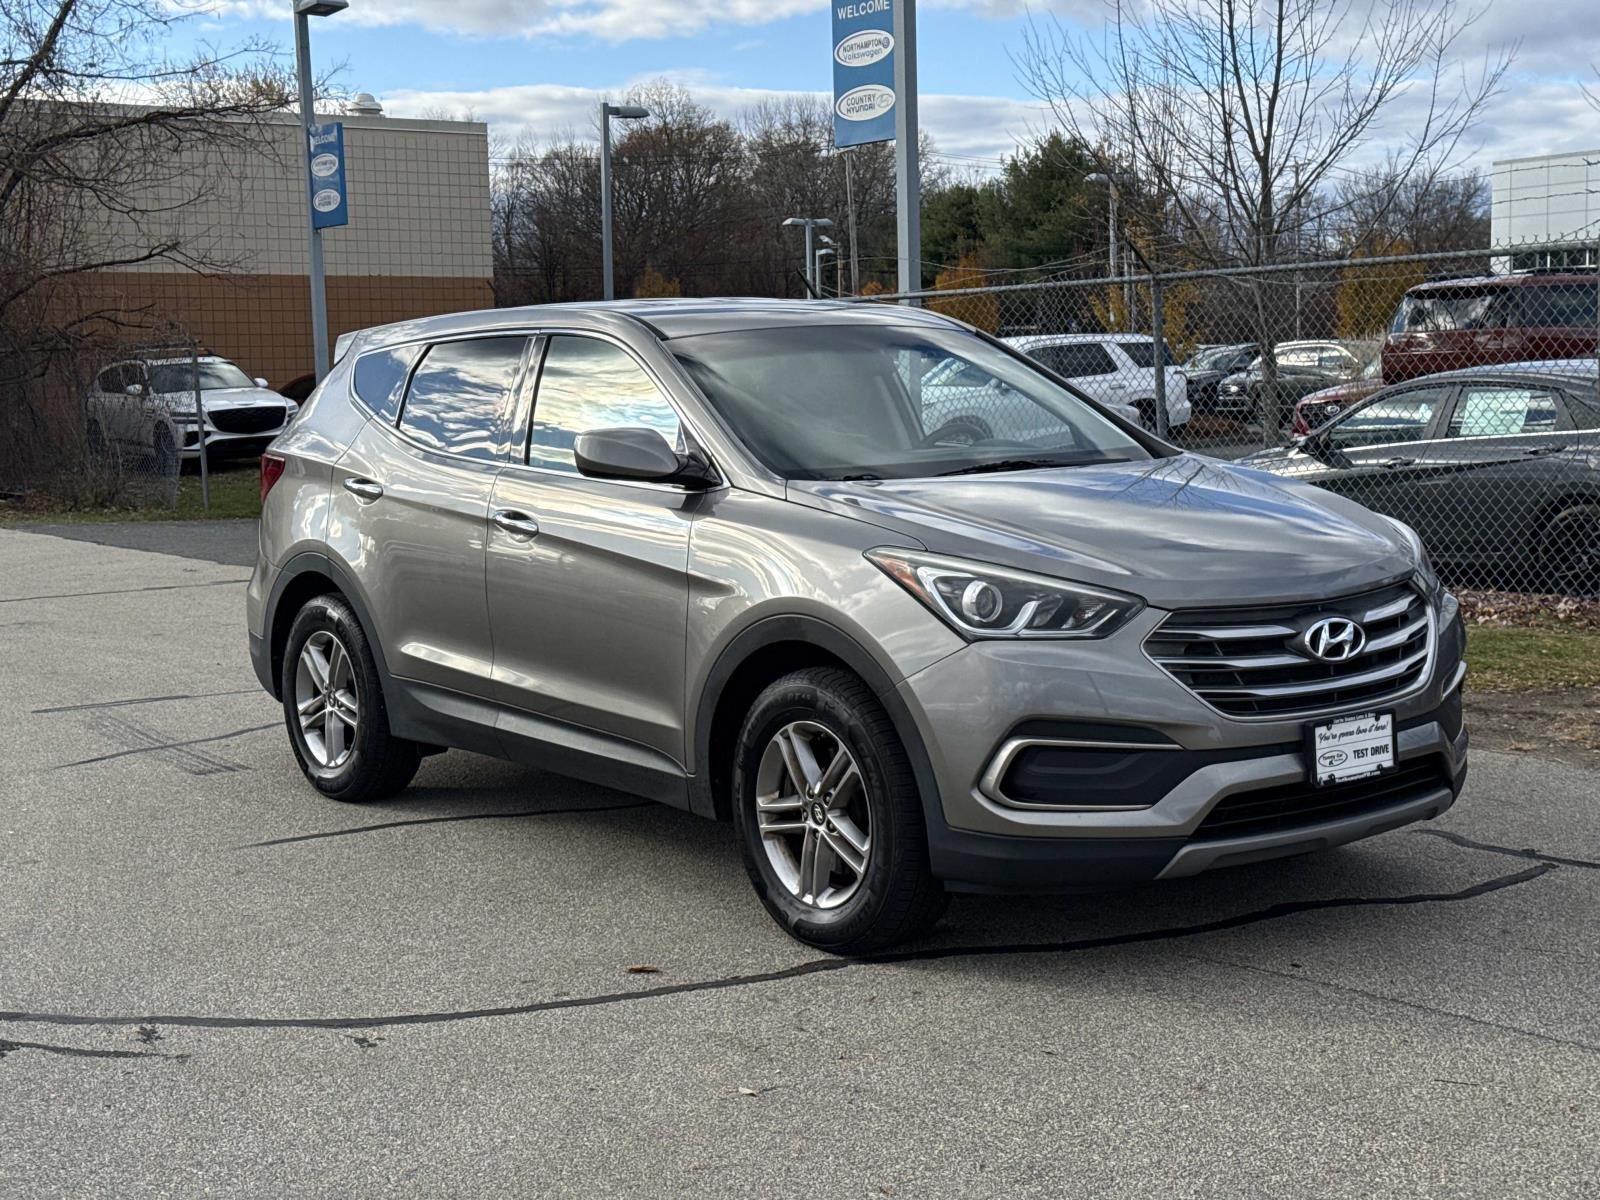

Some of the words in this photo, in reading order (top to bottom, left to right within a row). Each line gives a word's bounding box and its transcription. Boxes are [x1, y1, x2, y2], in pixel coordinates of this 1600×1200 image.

[837, 0, 890, 20] WELCOME
[842, 38, 884, 53] NORTHAMPTON
[843, 47, 883, 61] Volkswagen
[846, 93, 877, 107] COUNTRY
[846, 103, 876, 115] HYUNDAI
[1318, 731, 1337, 744] You're
[1356, 726, 1367, 735] love
[1353, 748, 1368, 760] TEST
[1370, 744, 1389, 756] DRIVE
